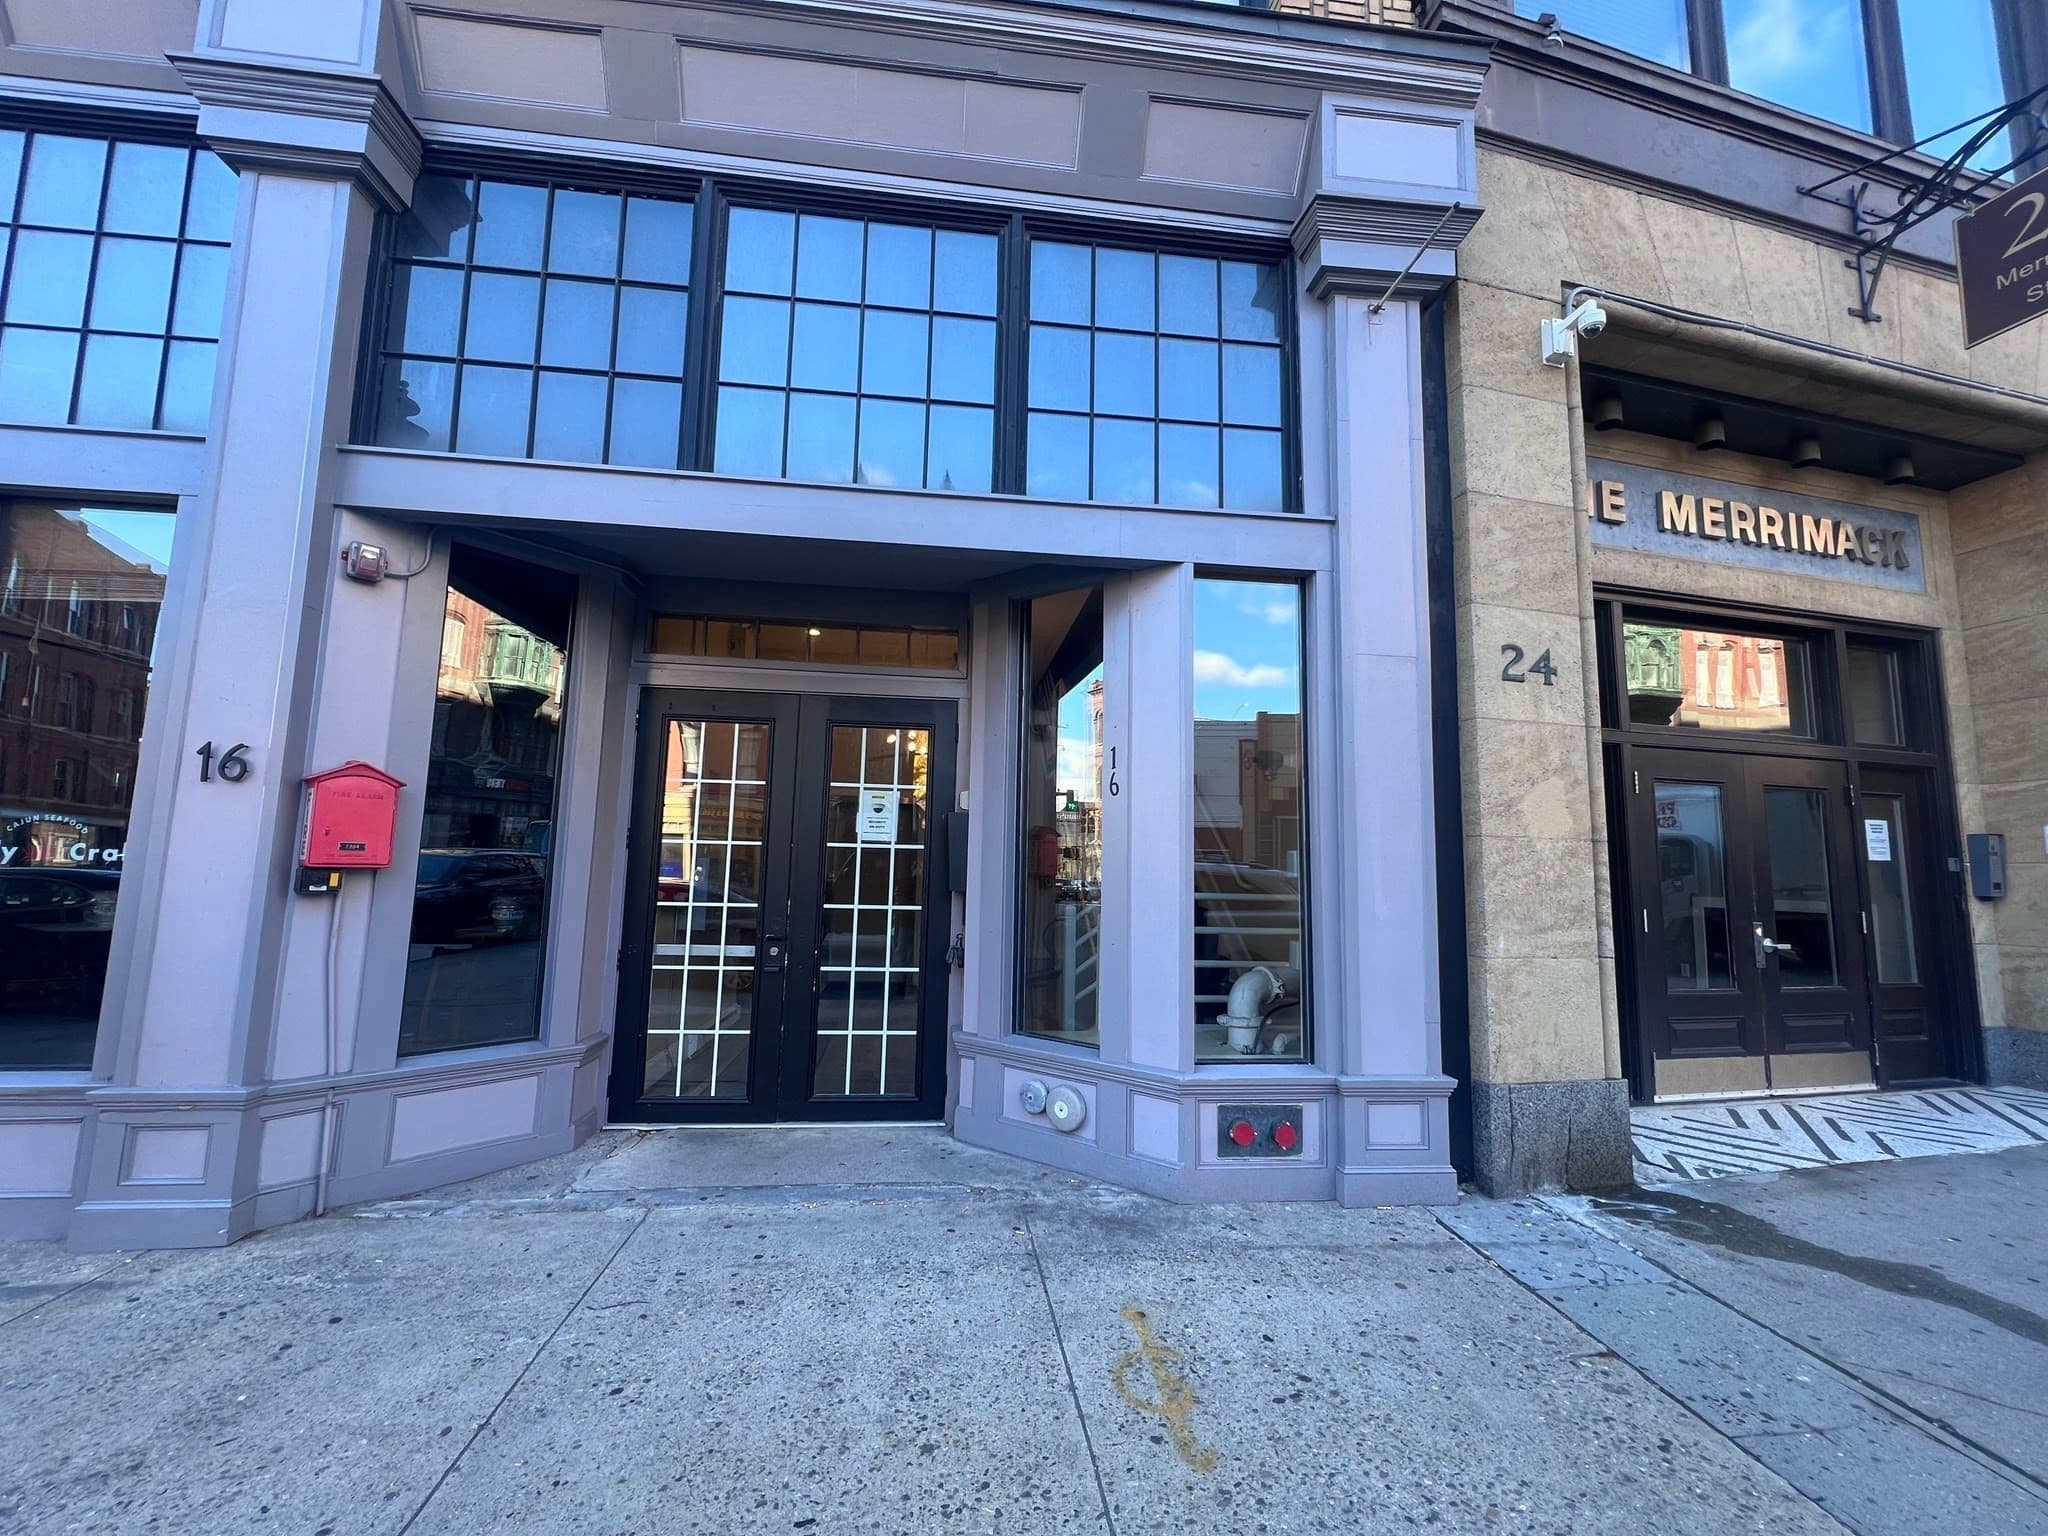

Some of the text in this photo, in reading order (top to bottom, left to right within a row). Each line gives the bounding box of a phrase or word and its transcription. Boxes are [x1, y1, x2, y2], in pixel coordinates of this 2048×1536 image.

[1658, 490, 1910, 569] MERRIMACK
[1501, 644, 1558, 686] 24
[196, 741, 249, 782] 16
[1110, 746, 1120, 797] 16
[6, 814, 88, 834] CAJUN SEAFOOD
[70, 842, 125, 862] Cra
